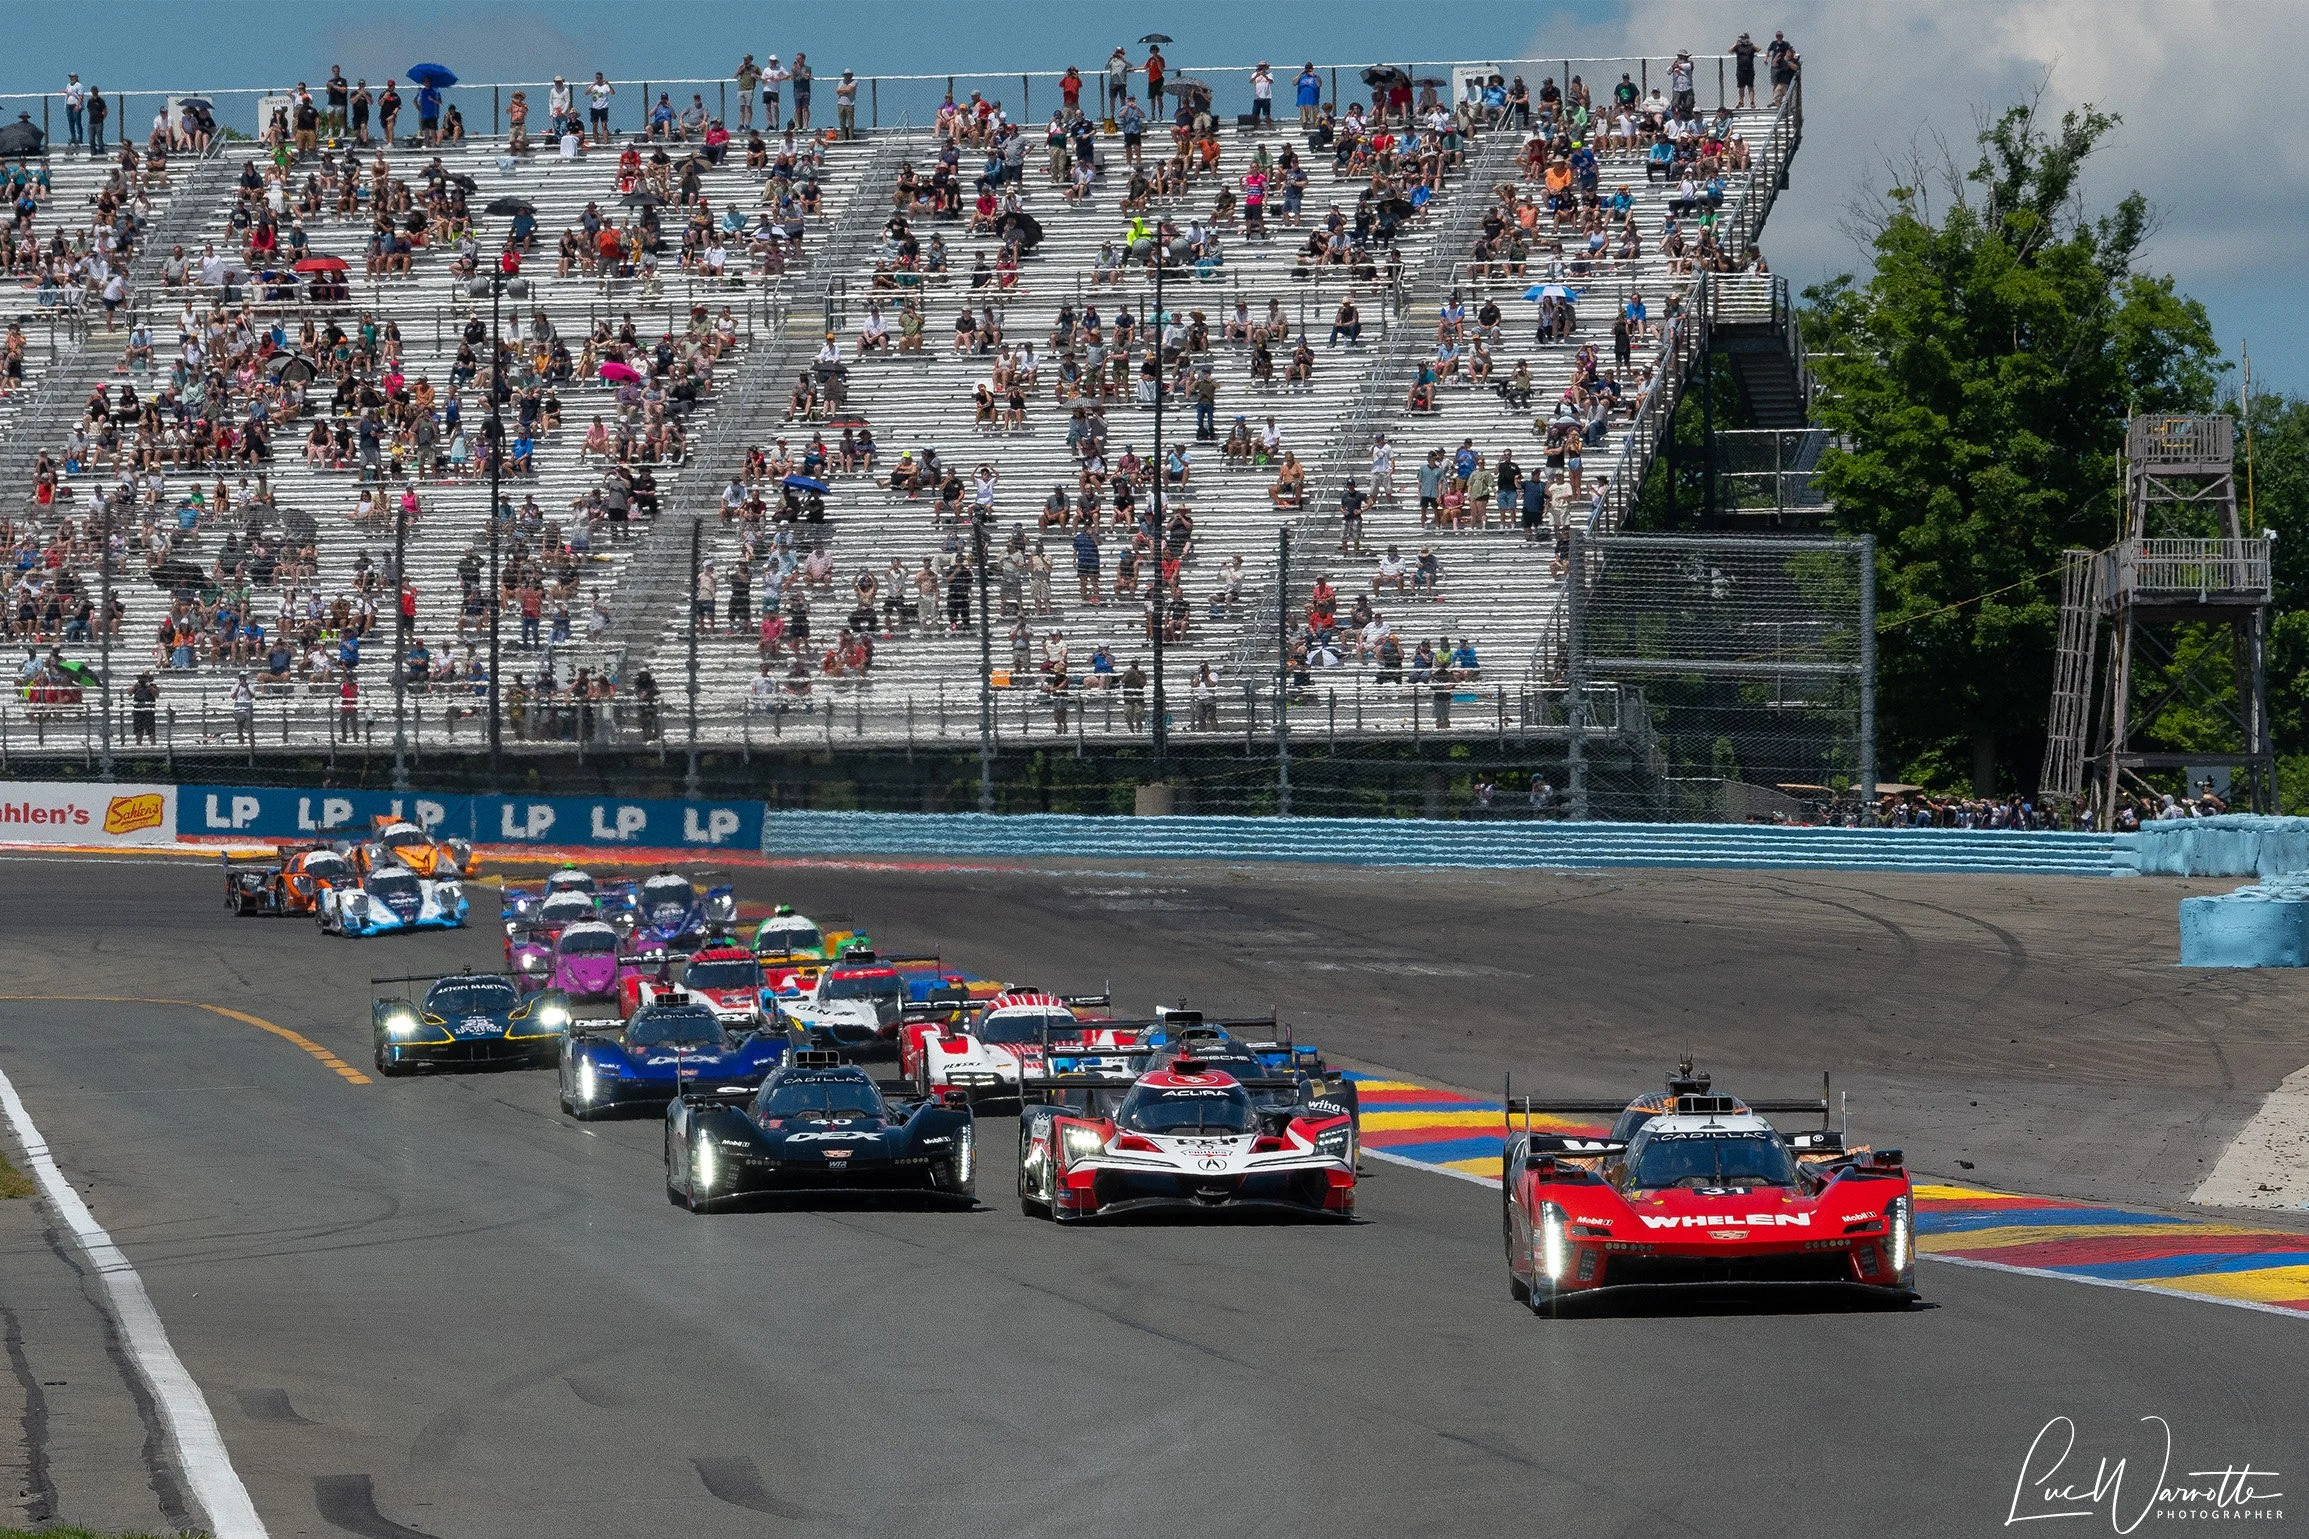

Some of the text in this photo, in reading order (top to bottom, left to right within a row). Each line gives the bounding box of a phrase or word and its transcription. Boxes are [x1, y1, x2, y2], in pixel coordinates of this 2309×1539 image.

[0, 802, 91, 825] hlen's
[110, 800, 160, 826] Sahlen's
[206, 793, 260, 829] LP
[298, 797, 353, 831] LP
[501, 803, 556, 839] LP
[591, 805, 647, 840] LP
[683, 806, 741, 843] LP
[436, 985, 468, 995] ASTON
[943, 1060, 983, 1071] PENSKE
[783, 1076, 865, 1085] CADILLAC
[1308, 1099, 1340, 1113] wiha
[809, 1118, 853, 1126] 40
[785, 1131, 886, 1143] DEX
[923, 1136, 943, 1145] Mobil
[1660, 1131, 1767, 1142] CADILLAC
[721, 1138, 743, 1148] Mobil
[828, 1160, 848, 1169] WTR
[1702, 1187, 1745, 1195] 31
[1577, 1216, 1602, 1225] Mobil
[1639, 1212, 1811, 1229] WHELEN
[1841, 1213, 1867, 1224] Mobil
